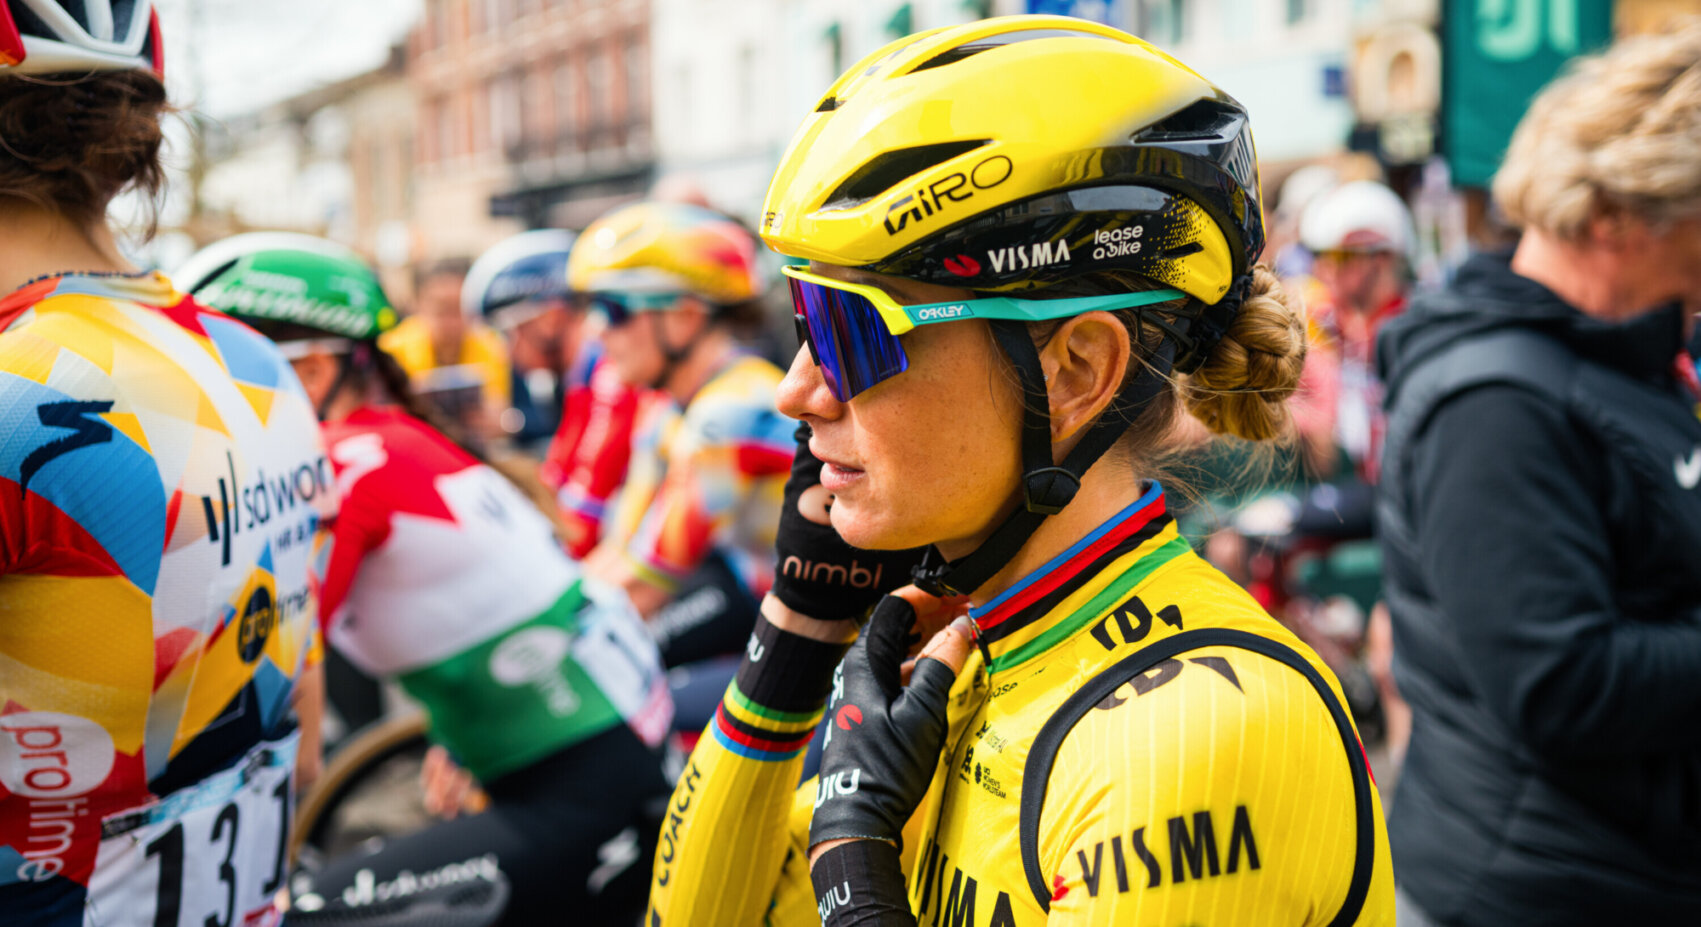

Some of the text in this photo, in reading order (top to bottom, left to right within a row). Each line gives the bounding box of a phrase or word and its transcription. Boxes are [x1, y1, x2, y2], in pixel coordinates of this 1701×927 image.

[883, 154, 1013, 236] GIRO
[987, 239, 1071, 273] VISMA
[1093, 225, 1144, 245] lease
[918, 304, 964, 320] OAKLEY
[782, 555, 883, 590] nimbl
[1, 725, 89, 882] protime
[145, 775, 290, 927] 131
[1077, 805, 1261, 898] VISMA
